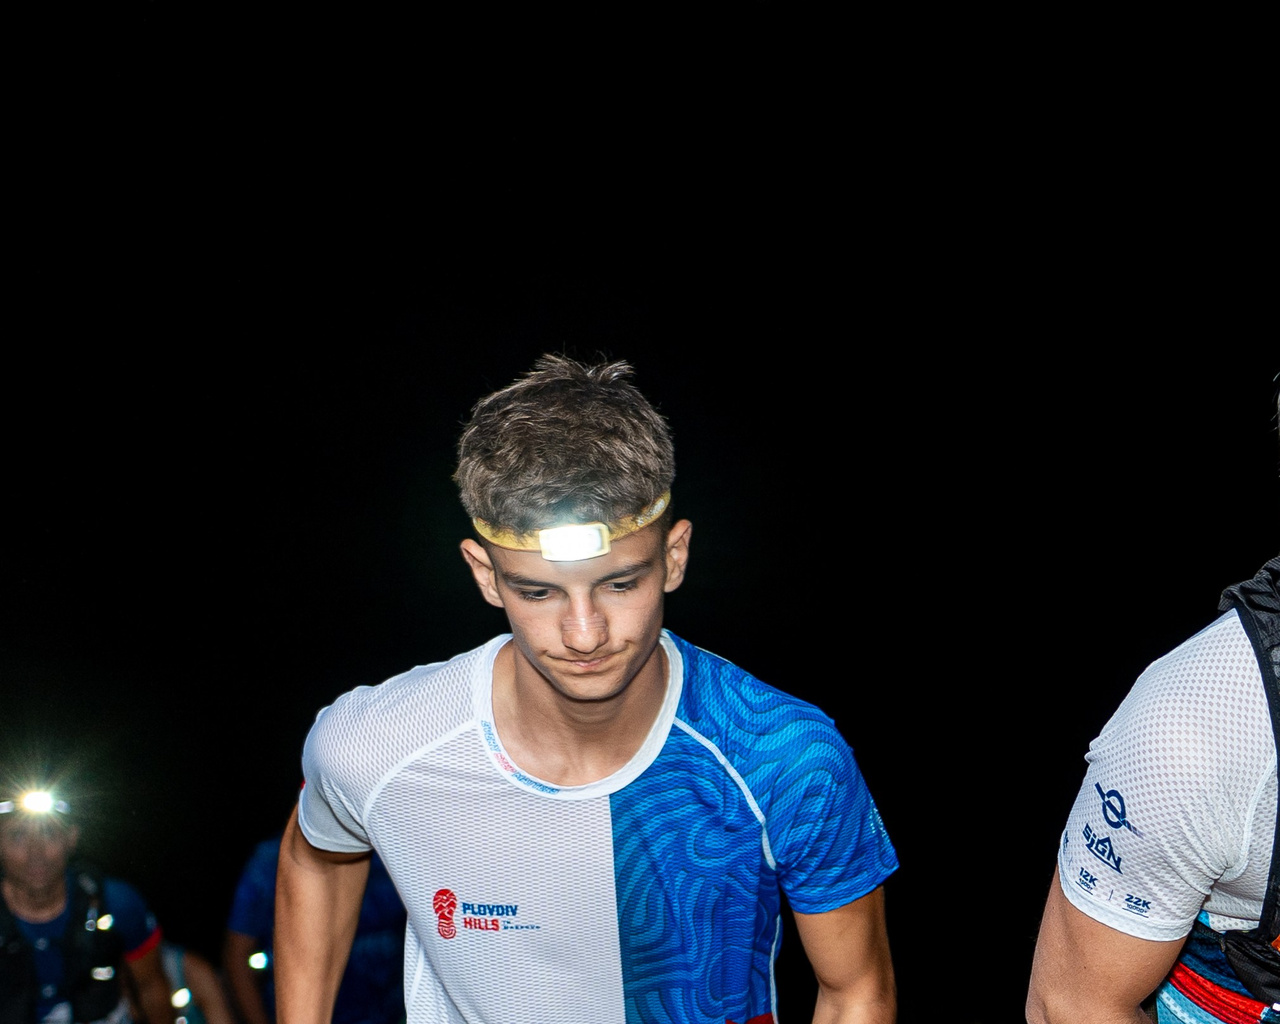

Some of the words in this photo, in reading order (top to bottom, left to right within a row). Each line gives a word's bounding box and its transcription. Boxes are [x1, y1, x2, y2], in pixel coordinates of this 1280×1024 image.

[1080, 867, 1099, 887] 12K
[1124, 893, 1152, 911] 22K
[462, 902, 518, 916] PLOVDIV
[464, 917, 500, 931] HILLS
